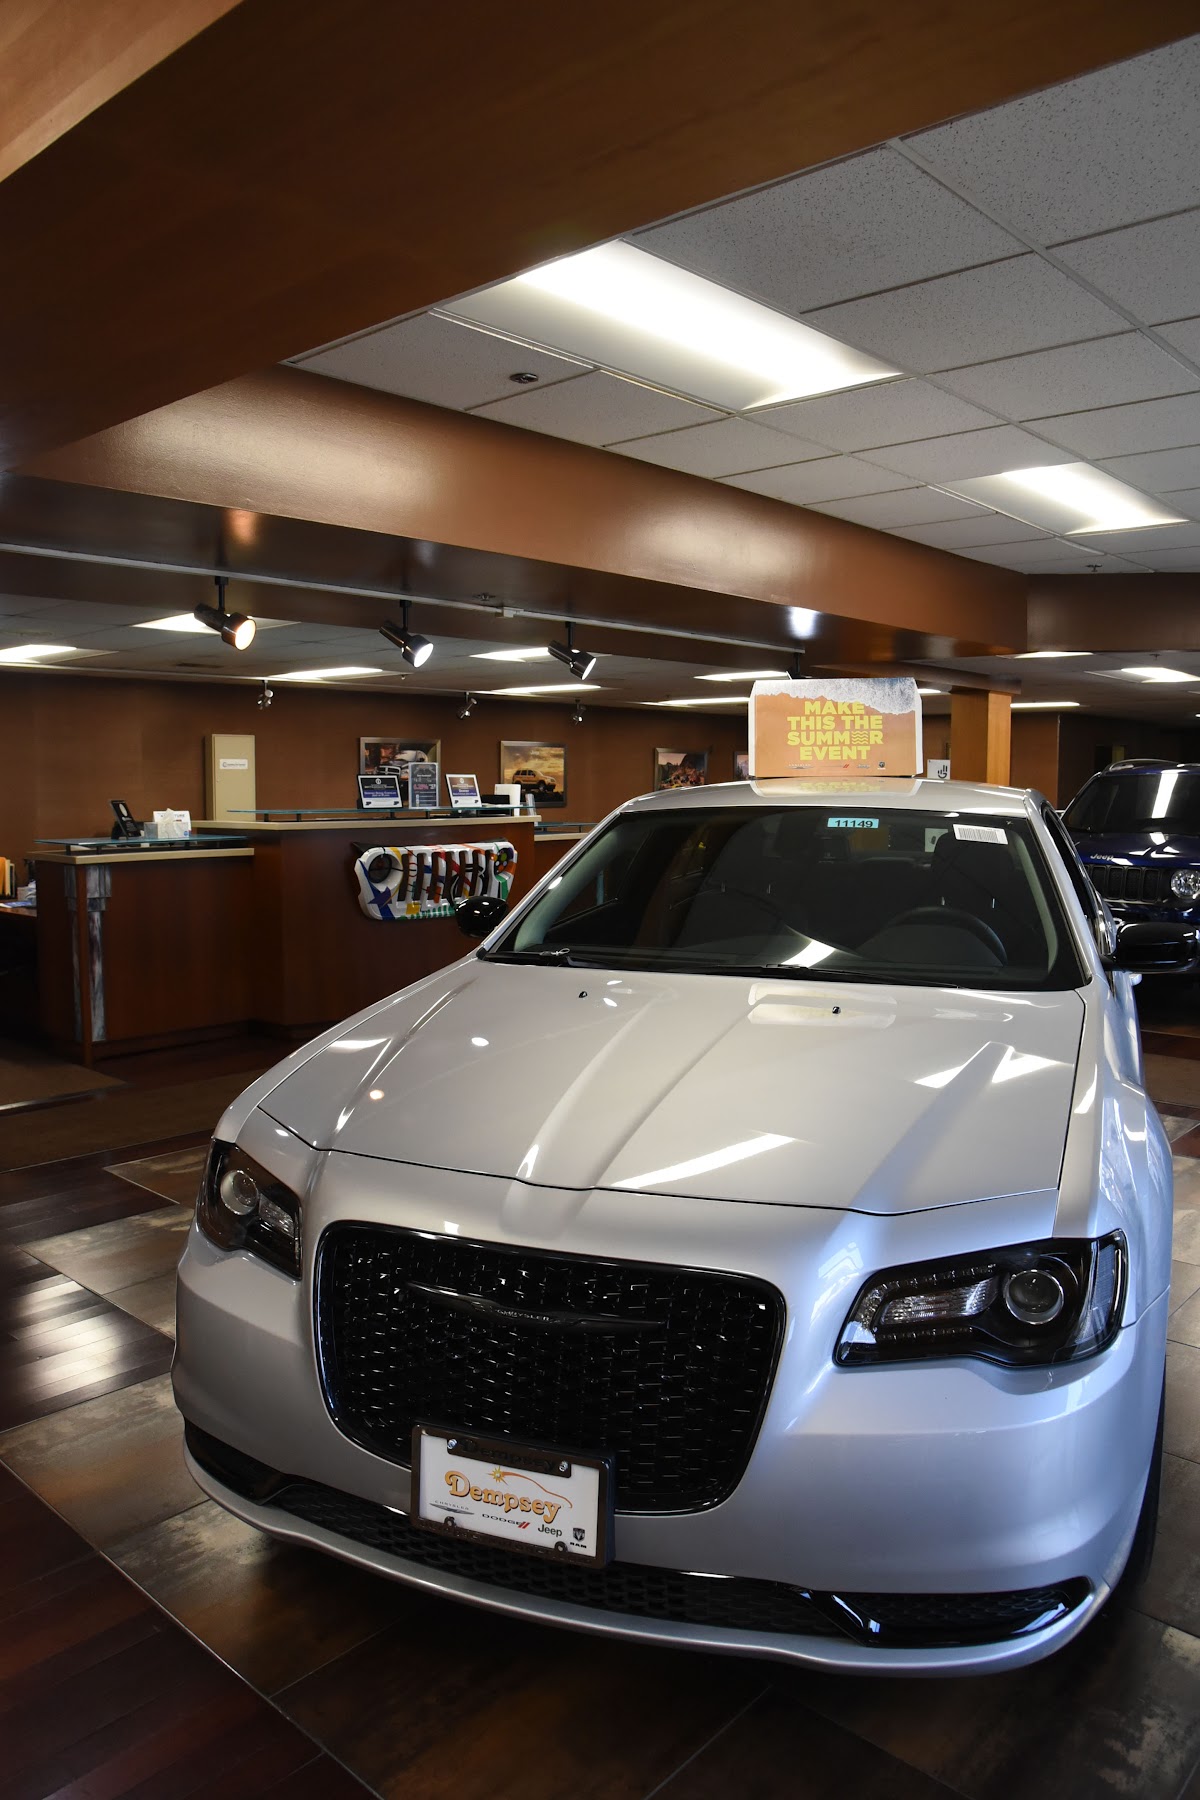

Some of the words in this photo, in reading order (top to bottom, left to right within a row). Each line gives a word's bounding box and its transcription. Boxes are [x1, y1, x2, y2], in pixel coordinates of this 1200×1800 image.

[804, 701, 865, 715] MAKE
[787, 716, 836, 731] THIS
[841, 715, 883, 730] THE
[800, 746, 871, 761] EVENT
[835, 819, 873, 828] 11149
[1090, 853, 1115, 861] Jeep
[445, 1470, 562, 1524] Dempsey
[434, 1500, 469, 1511] CHRYSLER
[482, 1513, 521, 1526] DODGE
[538, 1523, 563, 1537] Jeep
[570, 1541, 587, 1549] RAM
